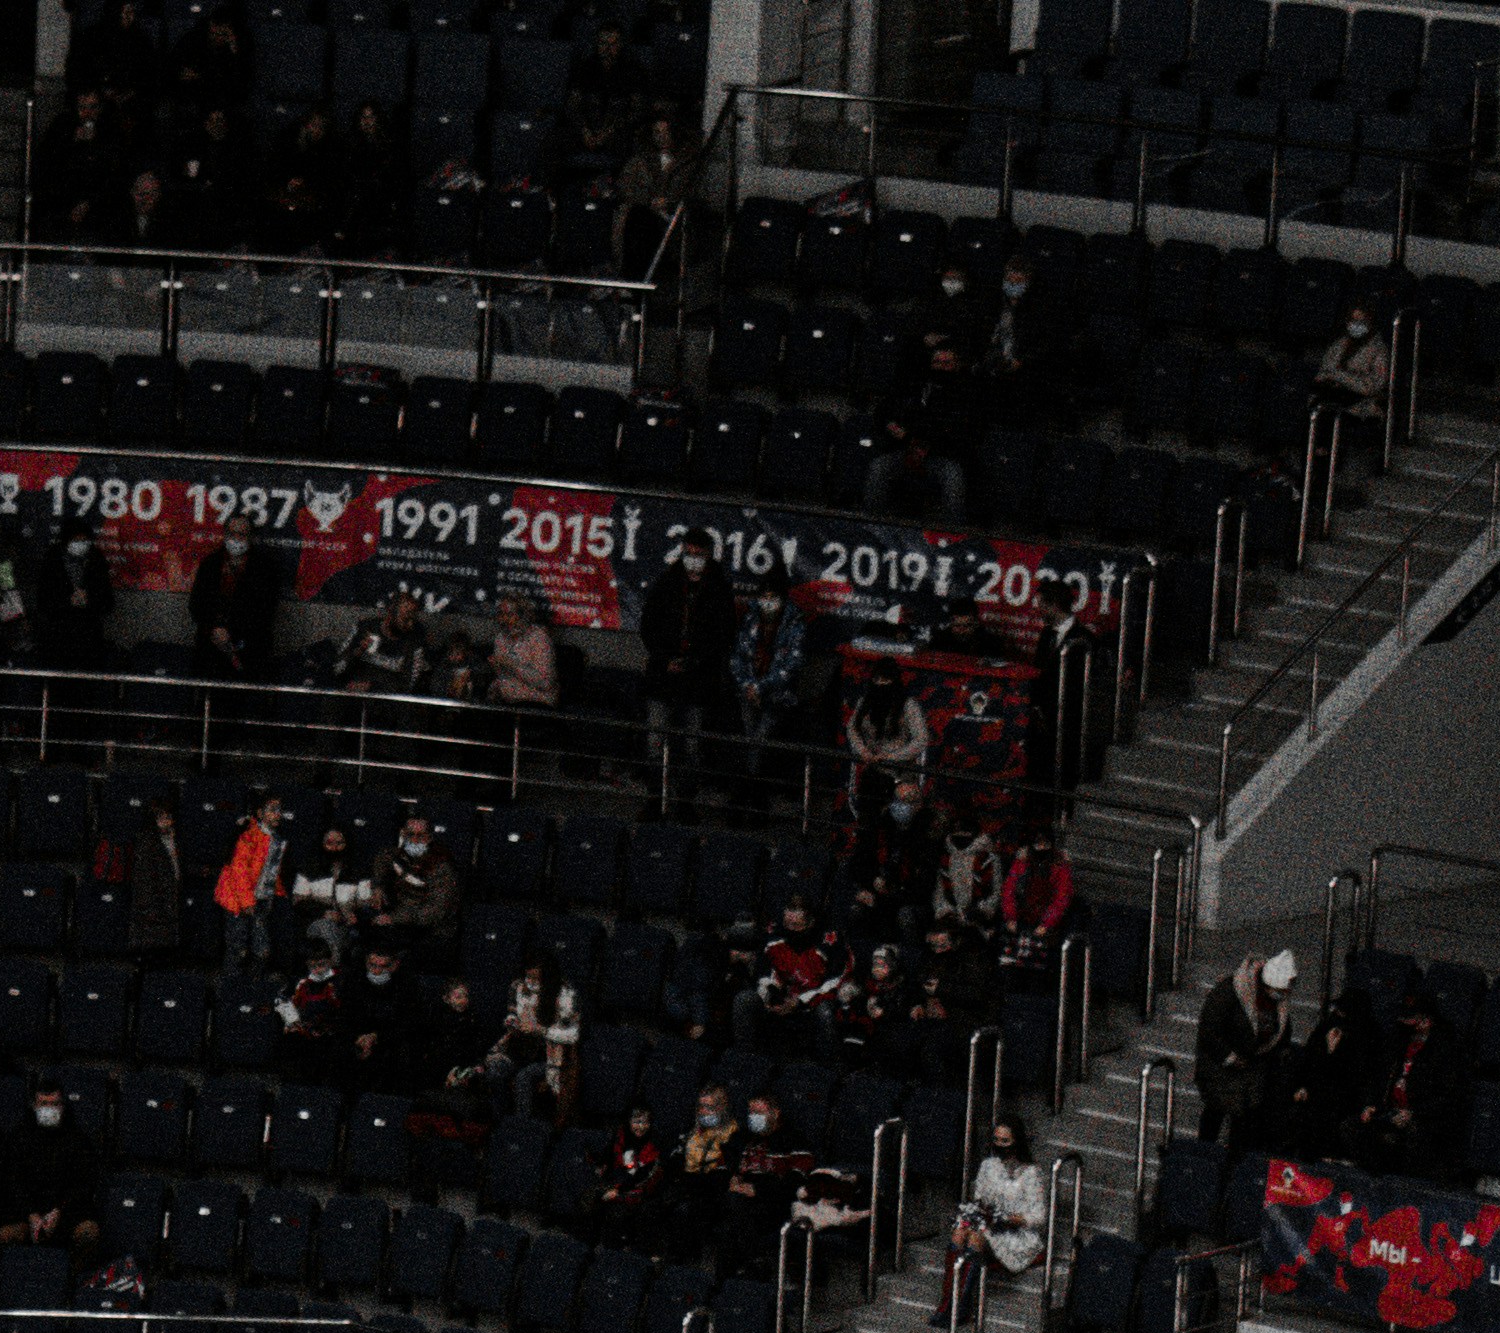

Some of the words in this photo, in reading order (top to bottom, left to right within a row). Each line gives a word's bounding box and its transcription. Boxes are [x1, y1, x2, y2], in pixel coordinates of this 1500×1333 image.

[44, 476, 162, 521] 1980
[185, 483, 298, 529] 1987
[375, 498, 479, 546] 1991
[499, 507, 613, 561] 2015
[821, 542, 927, 591] 2019
[1369, 1238, 1407, 1264] МЫ
